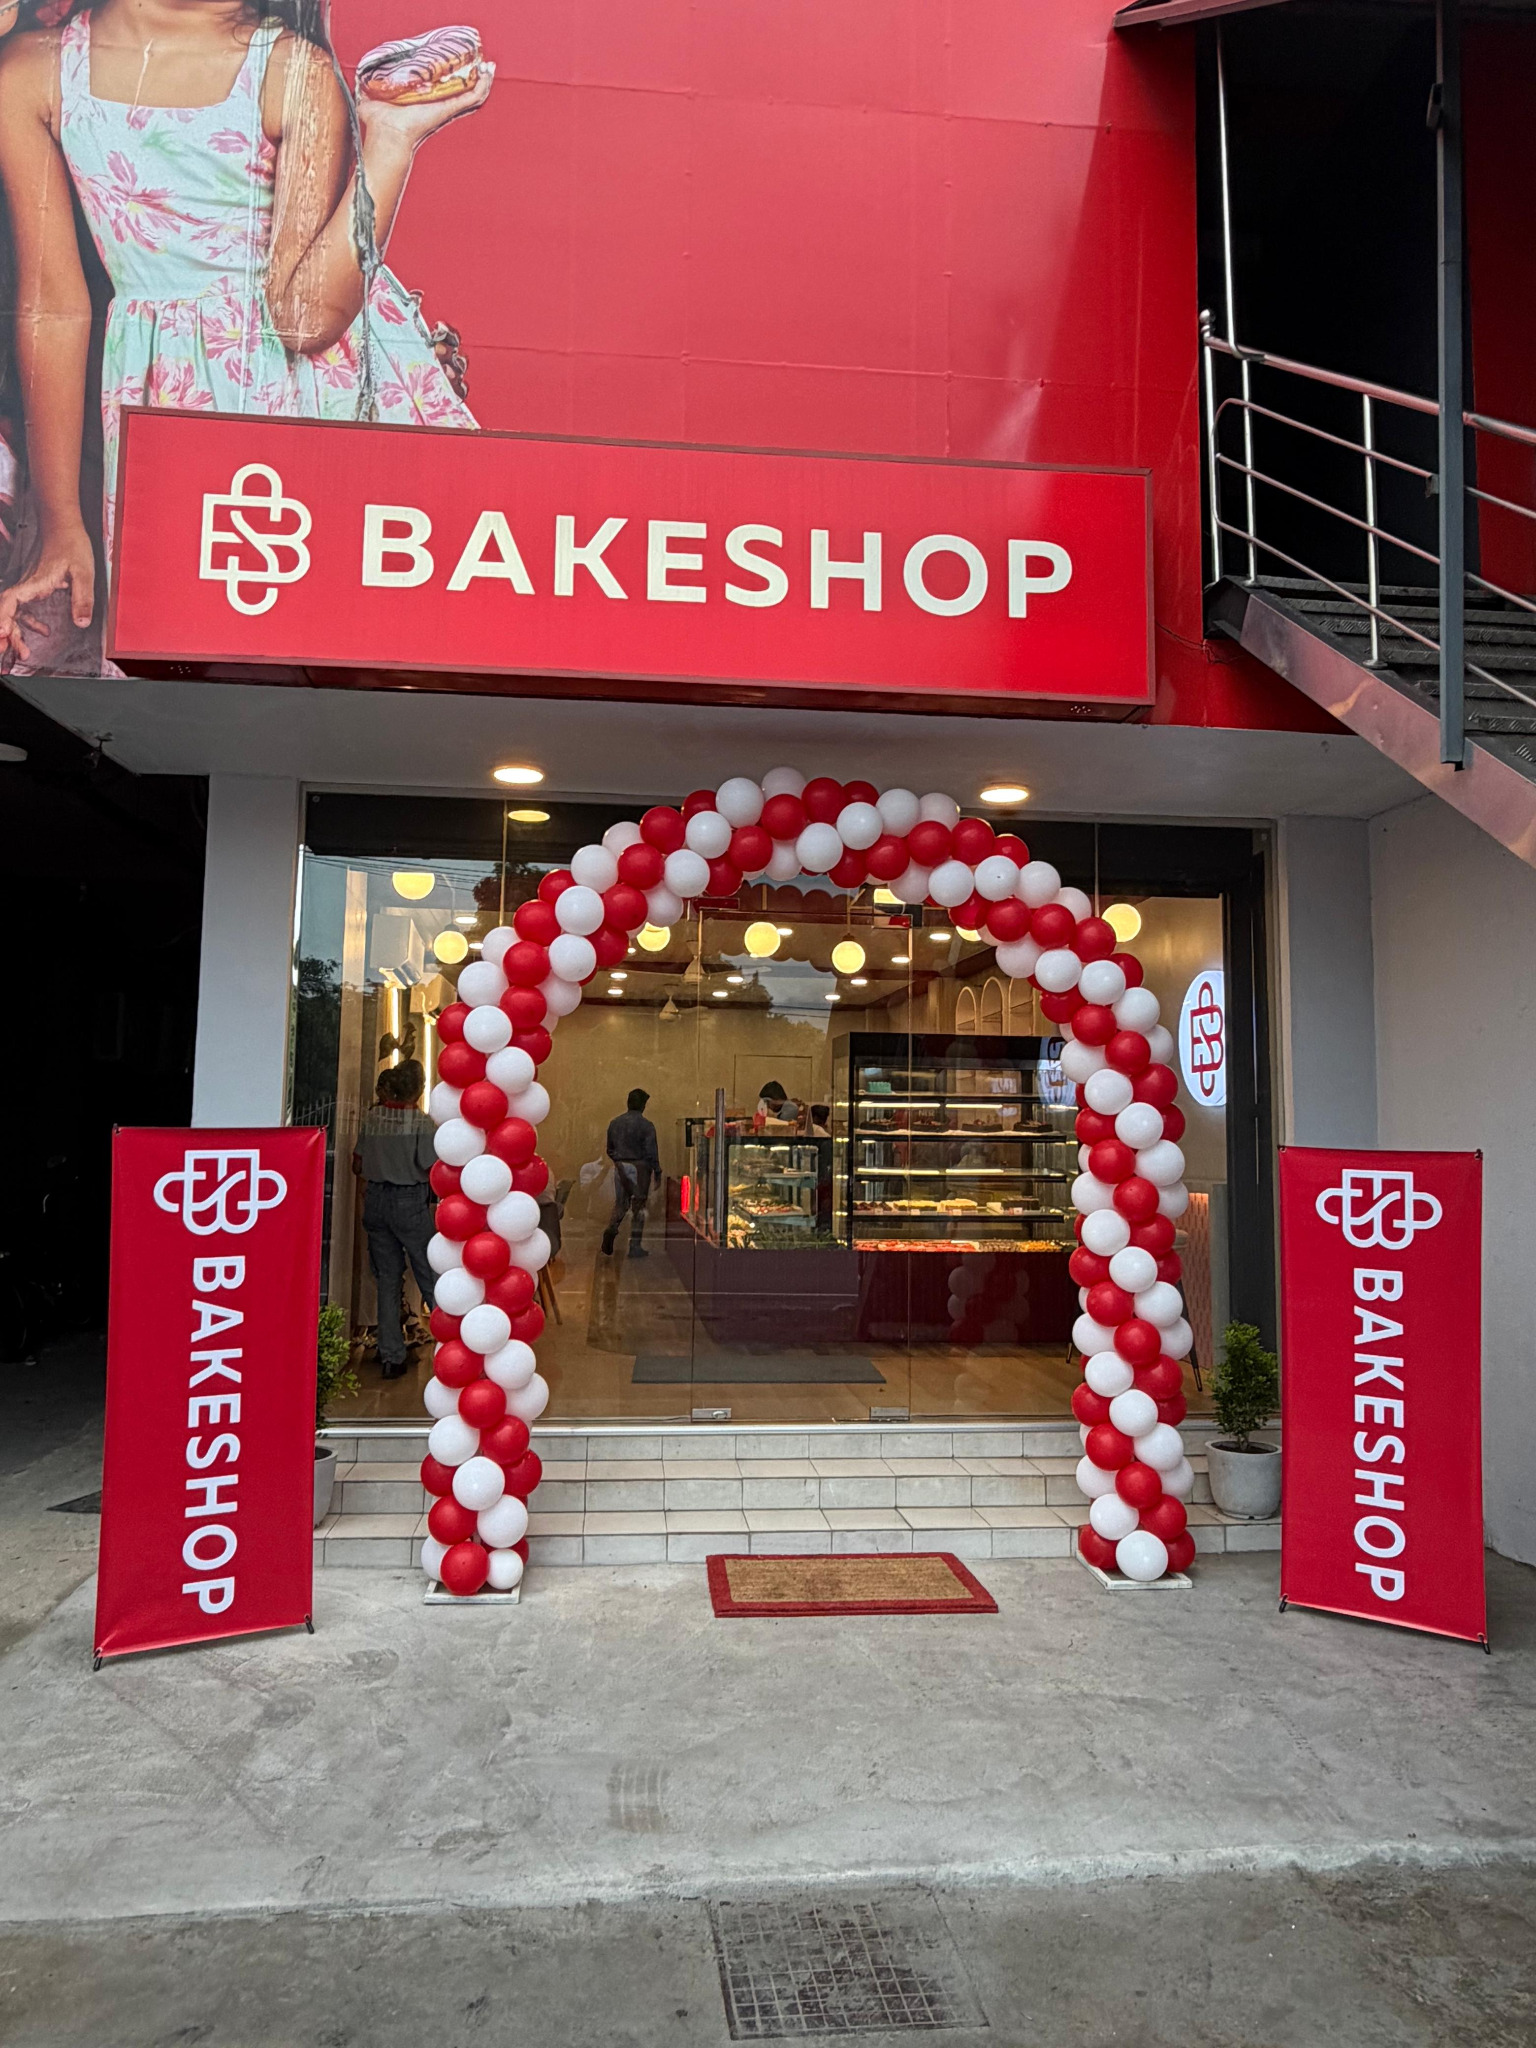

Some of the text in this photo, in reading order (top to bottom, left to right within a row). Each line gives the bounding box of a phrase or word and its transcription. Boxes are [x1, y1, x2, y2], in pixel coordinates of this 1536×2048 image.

[360, 503, 1074, 620] BAKESHOP
[181, 1255, 246, 1615] BAKESHOP
[1353, 1268, 1406, 1602] BAKESHOP
